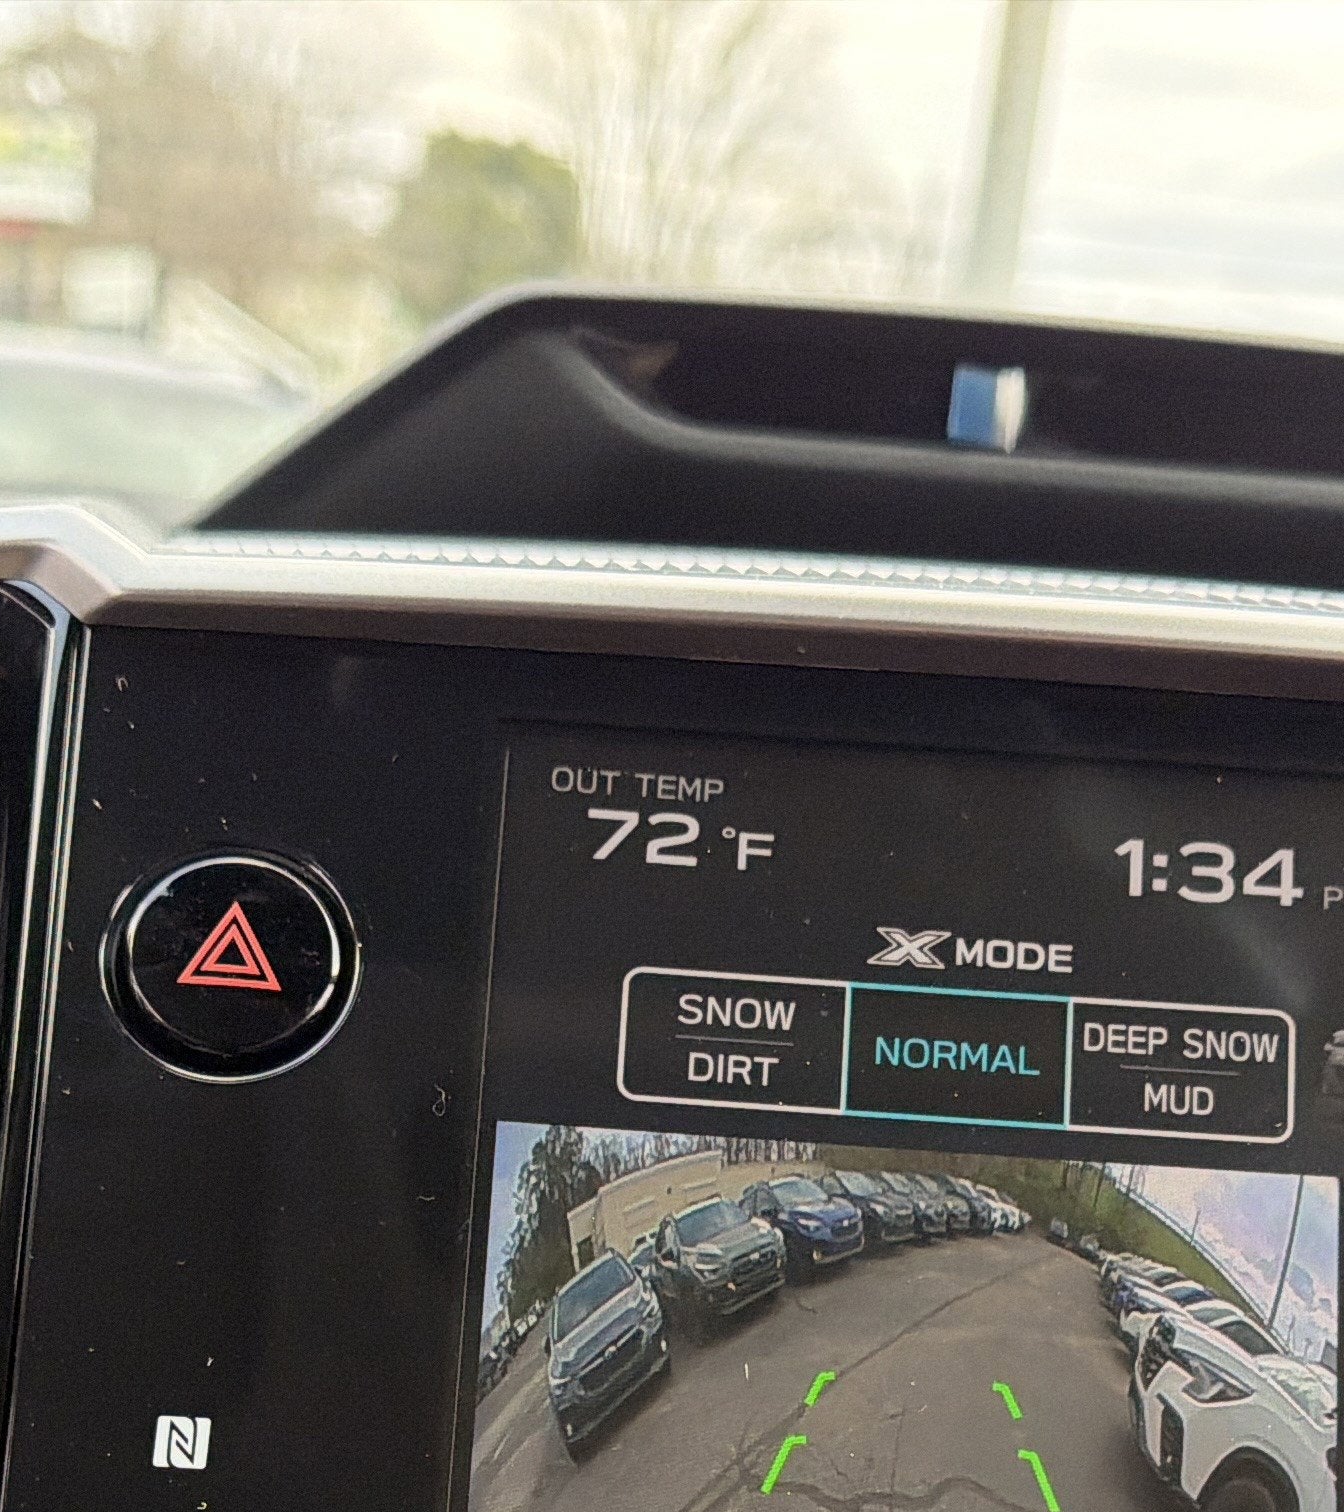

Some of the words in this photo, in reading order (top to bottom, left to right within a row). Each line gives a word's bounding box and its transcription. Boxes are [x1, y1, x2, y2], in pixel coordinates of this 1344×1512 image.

[551, 767, 621, 795] OUT
[635, 773, 724, 802] TEMP
[587, 808, 700, 867] 72
[1114, 838, 1304, 907] 1:34
[955, 937, 1074, 974] MODE
[677, 993, 796, 1031] SNOW
[875, 1036, 1040, 1076] NORMAL
[1083, 1022, 1169, 1056] DEEP
[1182, 1028, 1280, 1063] SNOW
[687, 1051, 780, 1087] DIRT
[1143, 1082, 1214, 1116] MUD
